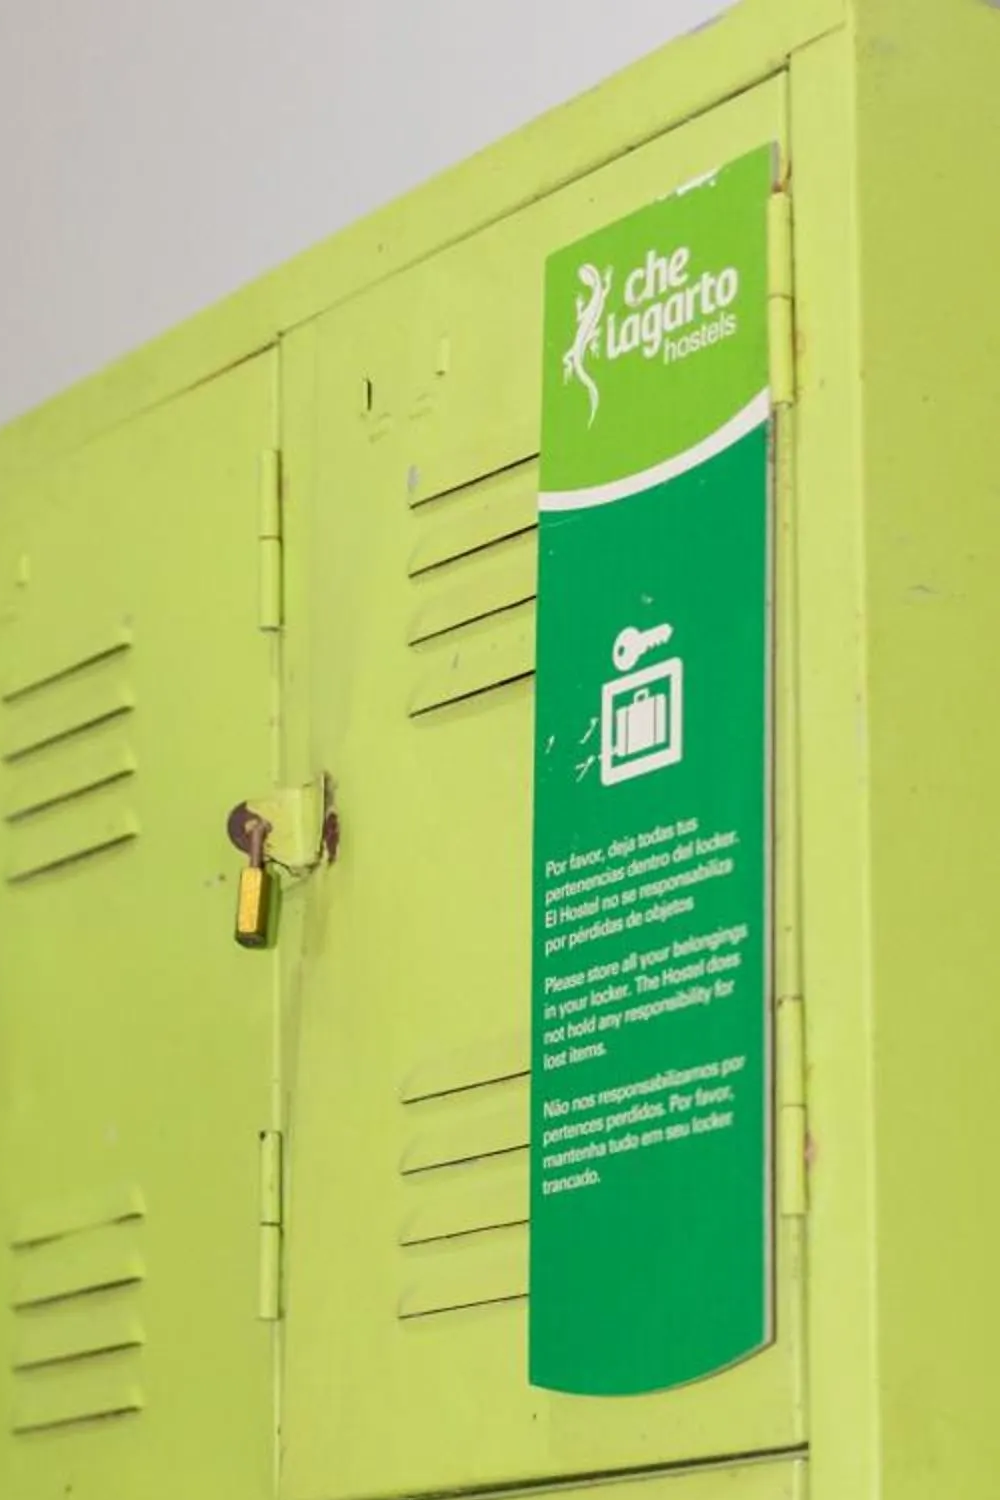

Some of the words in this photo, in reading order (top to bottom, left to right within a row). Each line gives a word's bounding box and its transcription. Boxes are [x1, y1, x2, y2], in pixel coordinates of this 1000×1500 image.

[625, 247, 689, 306] che
[664, 312, 737, 364] hostels
[545, 860, 567, 877] Por
[569, 849, 605, 870] favor,
[608, 836, 636, 858] deja
[638, 825, 674, 849] todas
[677, 818, 698, 835] tus
[545, 866, 625, 906] pertenencias
[627, 852, 670, 877] dentro
[672, 842, 693, 861] del
[696, 830, 740, 854] locker.
[545, 908, 557, 928] El
[560, 896, 599, 922] Hostel
[602, 893, 618, 910] no
[621, 889, 637, 904] se
[639, 858, 733, 898] responsabiliza
[545, 935, 567, 957] por
[569, 916, 623, 948] pérdidas
[626, 909, 643, 927] de
[645, 896, 694, 922] objetos
[544, 1004, 557, 1019] in
[559, 997, 588, 1019] your
[590, 984, 631, 1006] locker.
[635, 975, 659, 993] The
[662, 960, 704, 985] Hostel
[707, 952, 741, 973] does
[545, 971, 585, 994] Please
[587, 961, 619, 982] store
[622, 952, 638, 972] all
[640, 947, 671, 969] your
[673, 923, 748, 957] belongings
[543, 1027, 565, 1044] not
[568, 1015, 596, 1038] hold
[598, 1013, 622, 1028] any
[624, 985, 712, 1022] responsibility
[715, 980, 734, 997] for
[543, 1052, 567, 1071] lost
[569, 1042, 606, 1062] items.
[543, 1098, 569, 1120] Não
[572, 1094, 595, 1111] nos
[598, 1062, 719, 1105] responsabilizamos
[721, 1056, 746, 1077] por
[543, 1118, 604, 1147] pertences
[606, 1103, 666, 1132] perdidos.
[669, 1094, 692, 1112] Por
[543, 1144, 606, 1168] mantenha
[609, 1133, 639, 1154] tudo
[641, 1129, 663, 1146] em
[665, 1124, 690, 1141] seu
[692, 1112, 733, 1133] locker
